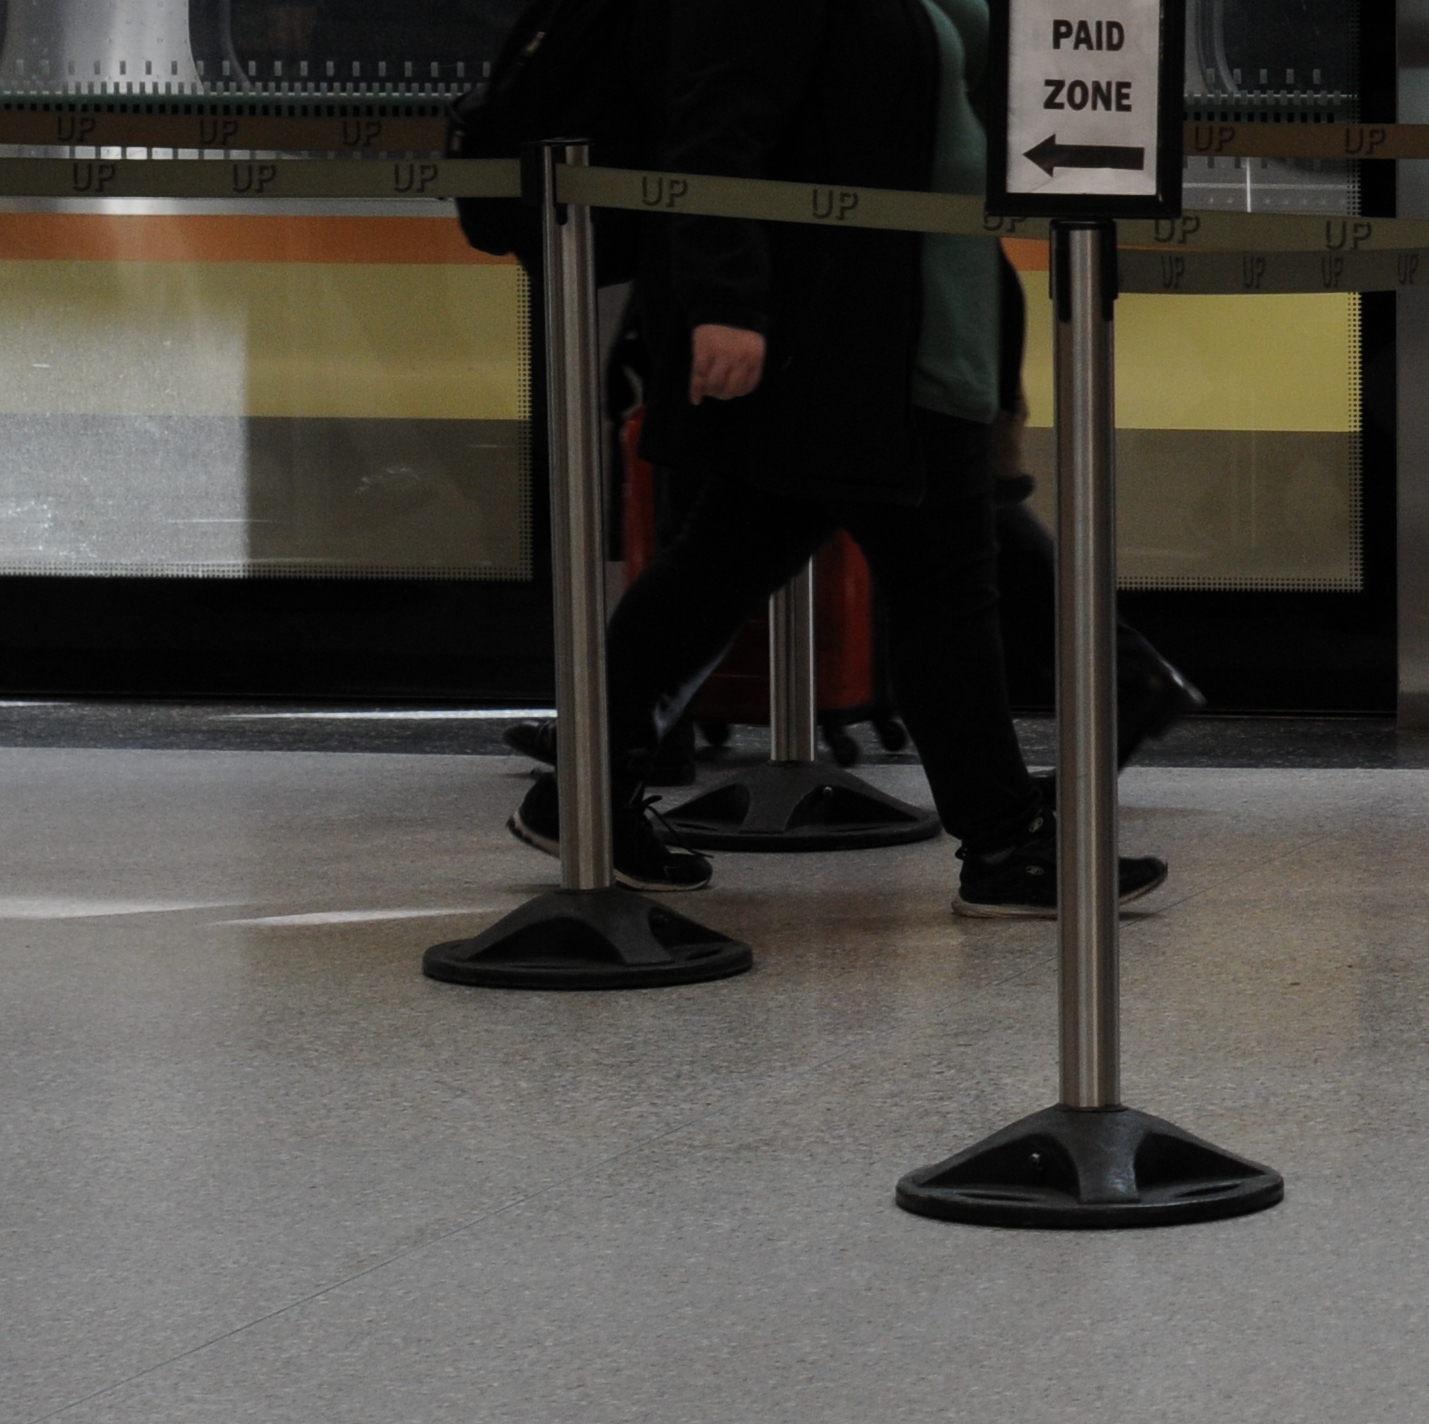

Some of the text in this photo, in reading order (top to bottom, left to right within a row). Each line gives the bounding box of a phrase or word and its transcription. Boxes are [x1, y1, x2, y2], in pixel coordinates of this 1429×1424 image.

[1053, 19, 1125, 51] PAID
[1043, 79, 1132, 112] ZONE
[57, 115, 382, 147] UP UP UP
[1193, 125, 1236, 153] UP
[1345, 127, 1386, 155] UP
[72, 163, 439, 194] UP UP UP
[642, 176, 688, 208] UP
[812, 188, 859, 221] UP
[1325, 220, 1373, 251] UP
[1161, 255, 1186, 289] UP
[1242, 255, 1266, 289] UP
[1321, 255, 1344, 289] UP
[1398, 253, 1419, 285] UP
